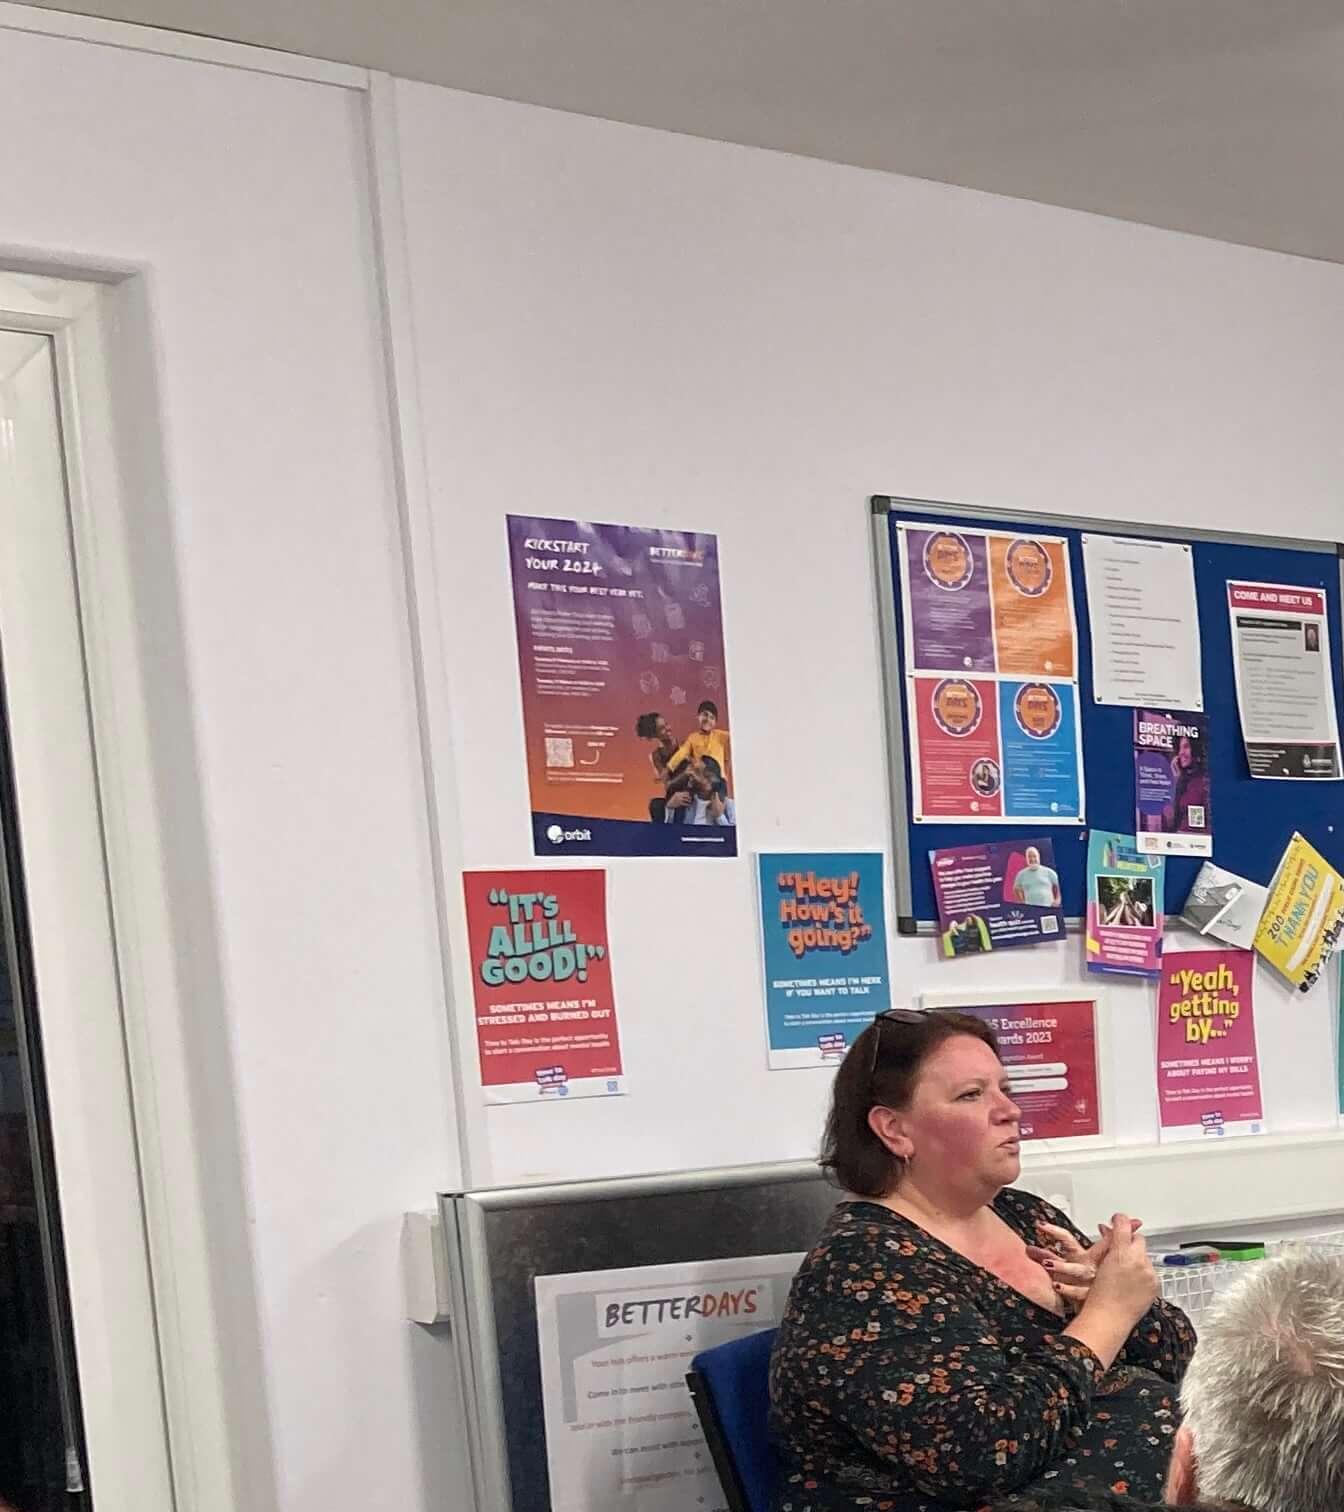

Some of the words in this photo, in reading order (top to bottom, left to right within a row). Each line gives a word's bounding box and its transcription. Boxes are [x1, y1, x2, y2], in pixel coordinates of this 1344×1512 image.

[524, 538, 590, 554] KICKSTART
[525, 556, 559, 570] YOUR
[563, 559, 602, 576] 2024
[1234, 590, 1259, 601] COME
[1260, 592, 1278, 603] AND
[1279, 594, 1300, 605] MEET
[1302, 595, 1313, 606] US
[1139, 722, 1199, 738] BREATHING
[1138, 734, 1173, 747] SPACE
[565, 829, 592, 841] orbit
[779, 898, 844, 926] How's
[848, 904, 864, 925] it
[1275, 900, 1307, 947] THANK
[1299, 863, 1319, 899] YOU
[1267, 915, 1285, 939] 200
[488, 920, 577, 957] ALLLL
[773, 979, 817, 989] SOMETIMES
[819, 978, 847, 987] MEANS
[861, 976, 881, 985] HERE
[786, 988, 794, 997] IF
[797, 988, 813, 997] YOU
[814, 987, 836, 996] WANT
[838, 987, 849, 995] TO
[850, 986, 870, 995] TALK
[489, 1002, 545, 1014] SOMETIMES
[547, 1000, 580, 1010] MEANS
[581, 999, 597, 1008] I'M
[1170, 993, 1239, 1022] getting
[478, 1014, 526, 1026] STRESSED
[527, 1012, 549, 1022] AND
[550, 1010, 590, 1021] BURNED
[591, 1009, 611, 1018] OUT
[1001, 1018, 1058, 1029] Excellence
[996, 1033, 1024, 1044] ards
[1026, 1031, 1053, 1044] 2023
[1161, 1059, 1199, 1068] SOMETIMES
[1201, 1058, 1223, 1067] MEANS
[1230, 1056, 1253, 1065] WORRY
[1167, 1069, 1190, 1078] ABOUT
[1192, 1068, 1217, 1077] PAYING
[1218, 1067, 1229, 1075] MY
[1230, 1066, 1248, 1074] BILLS
[605, 1289, 757, 1328] BETTERDAYS
[588, 1391, 609, 1399] Come
